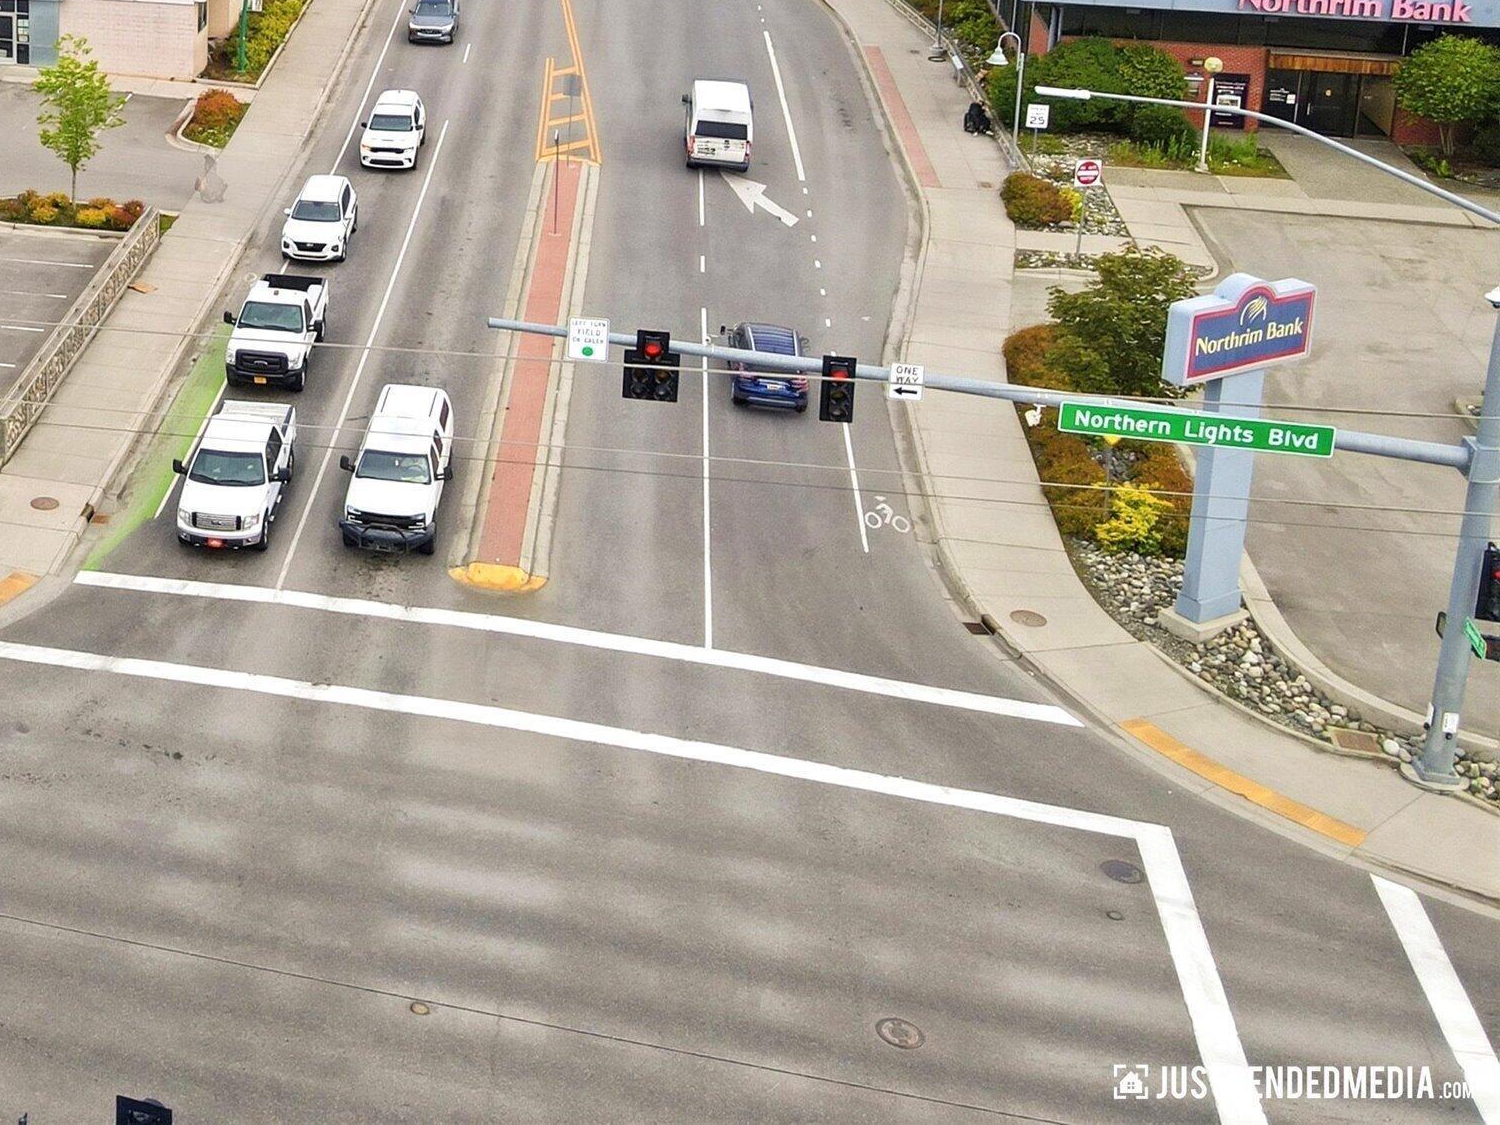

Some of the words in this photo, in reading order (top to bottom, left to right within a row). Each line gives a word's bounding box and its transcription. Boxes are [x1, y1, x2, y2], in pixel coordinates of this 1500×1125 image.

[1029, 115, 1046, 125] 25
[1195, 327, 1263, 357] Northrim
[1266, 316, 1304, 340] Bank
[896, 365, 919, 376] ONE
[1074, 408, 1171, 436] Northern
[1184, 419, 1254, 445] Lights
[1268, 428, 1319, 450] Blvd
